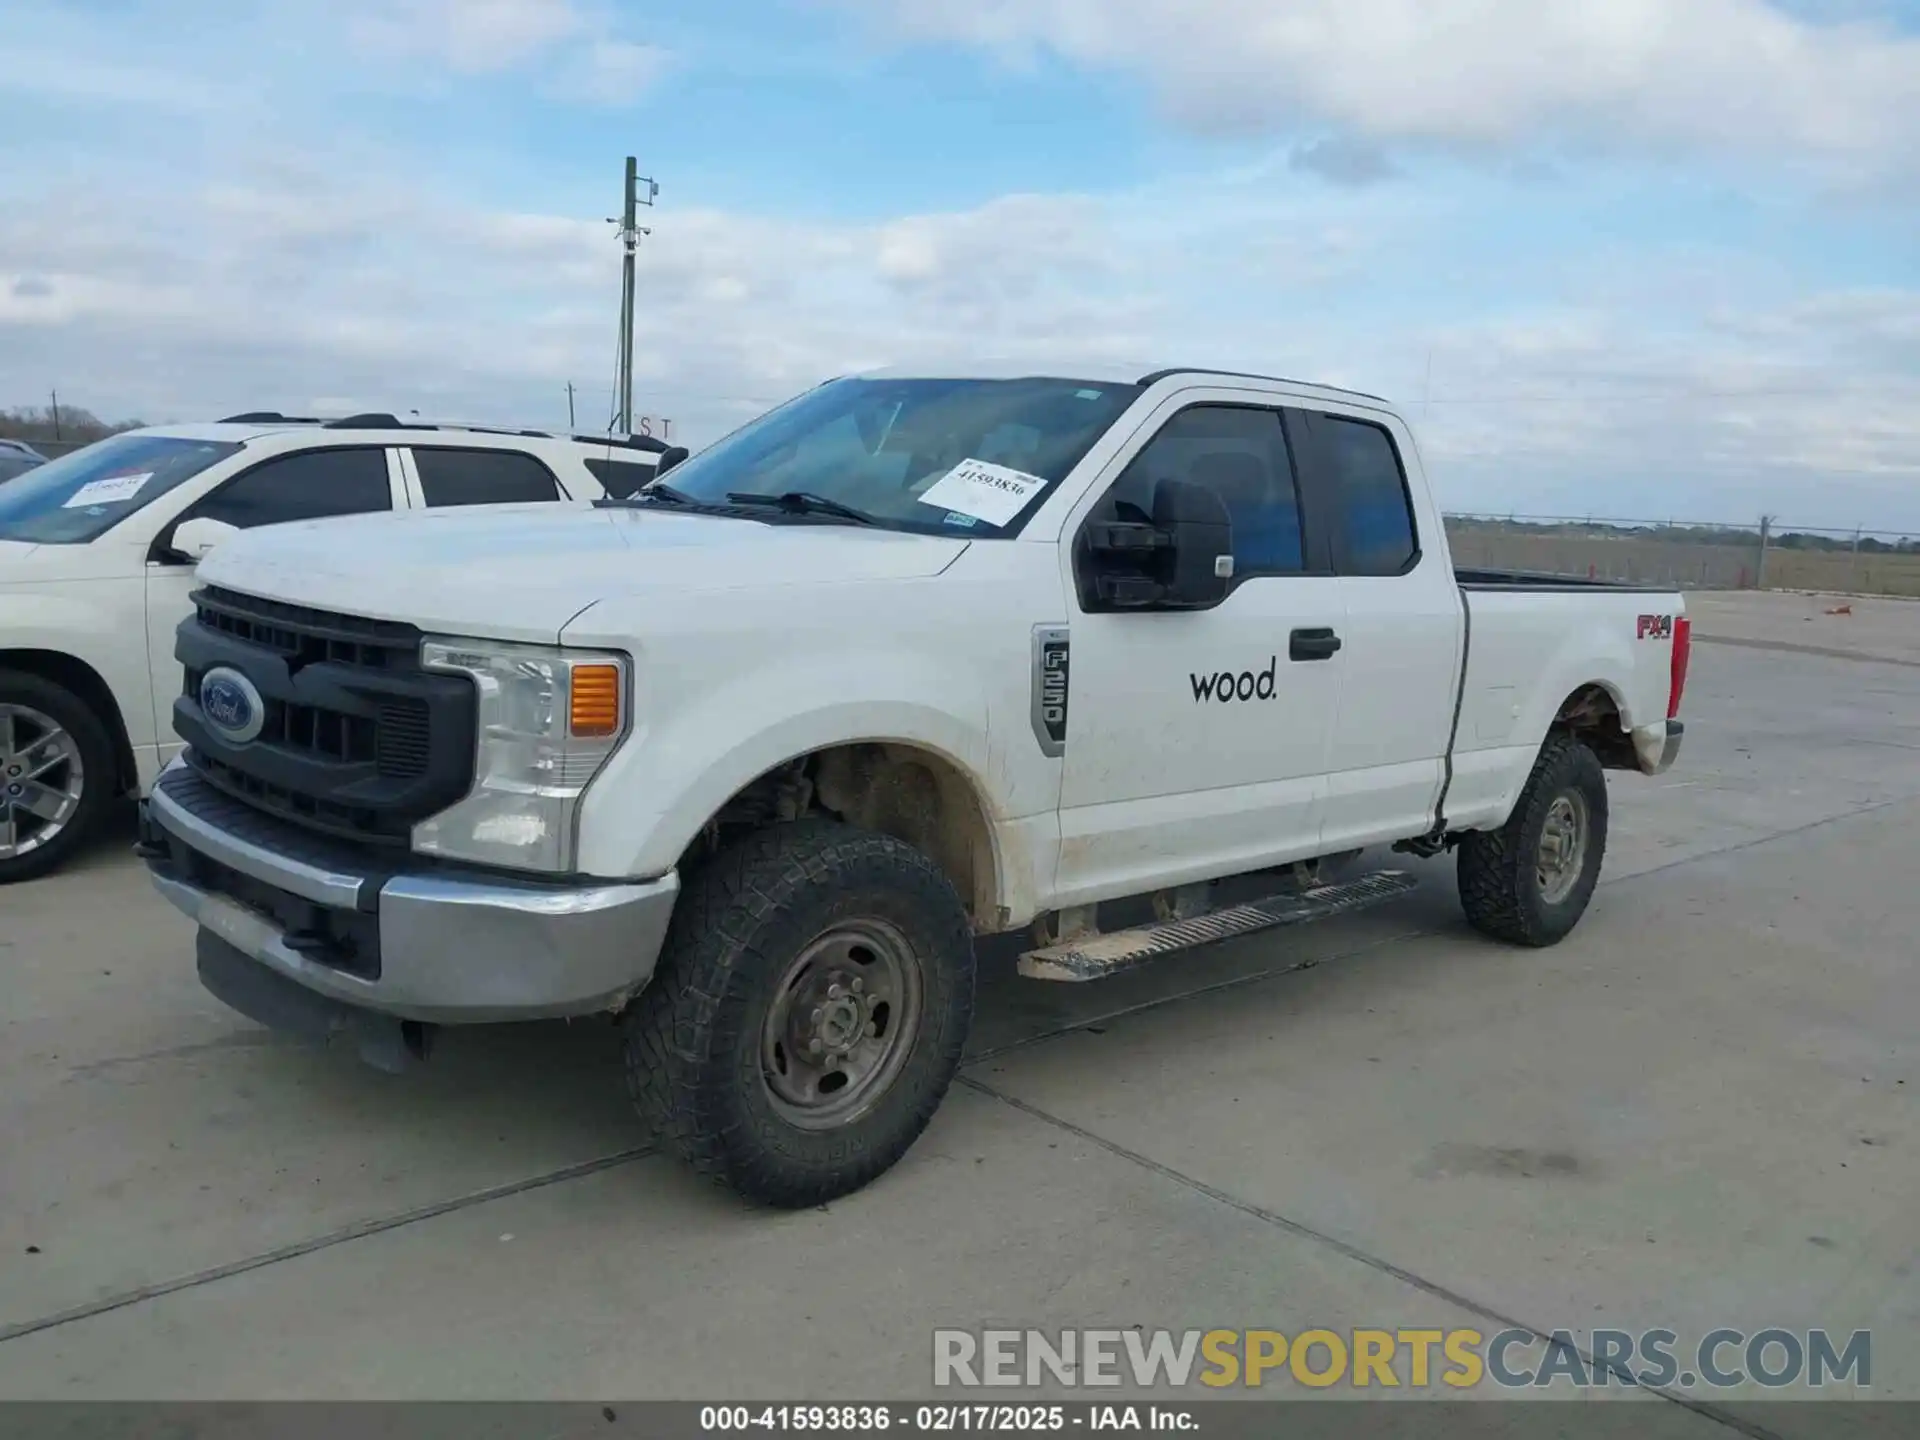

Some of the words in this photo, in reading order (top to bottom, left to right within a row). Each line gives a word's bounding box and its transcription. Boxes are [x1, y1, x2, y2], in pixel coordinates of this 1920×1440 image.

[957, 469, 1026, 496] 41593836
[1637, 614, 1672, 639] FX4
[1189, 655, 1278, 704] wood.
[208, 685, 239, 723] Ford
